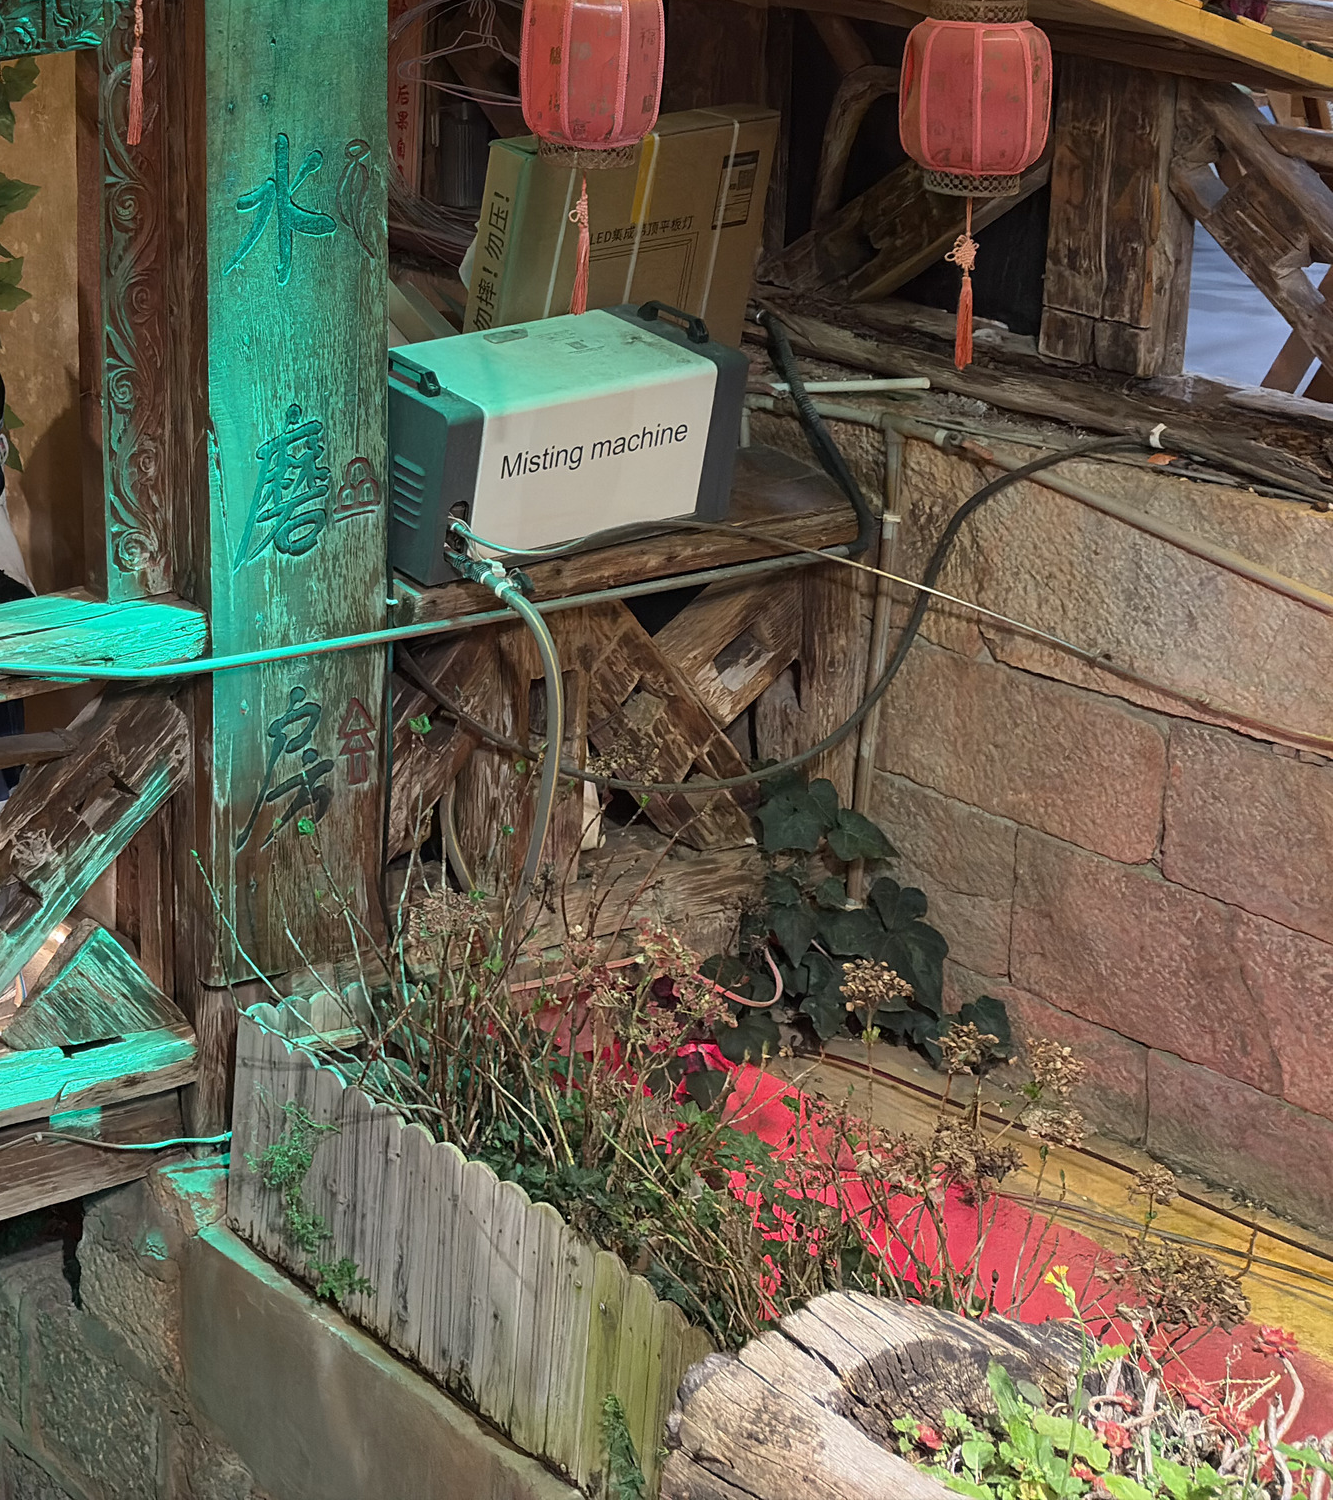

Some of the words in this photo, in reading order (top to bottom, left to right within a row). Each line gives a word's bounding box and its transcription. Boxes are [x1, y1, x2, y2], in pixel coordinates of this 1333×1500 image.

[223, 132, 337, 851] 水磨房
[499, 441, 585, 483] Misting
[589, 419, 689, 462] machine
